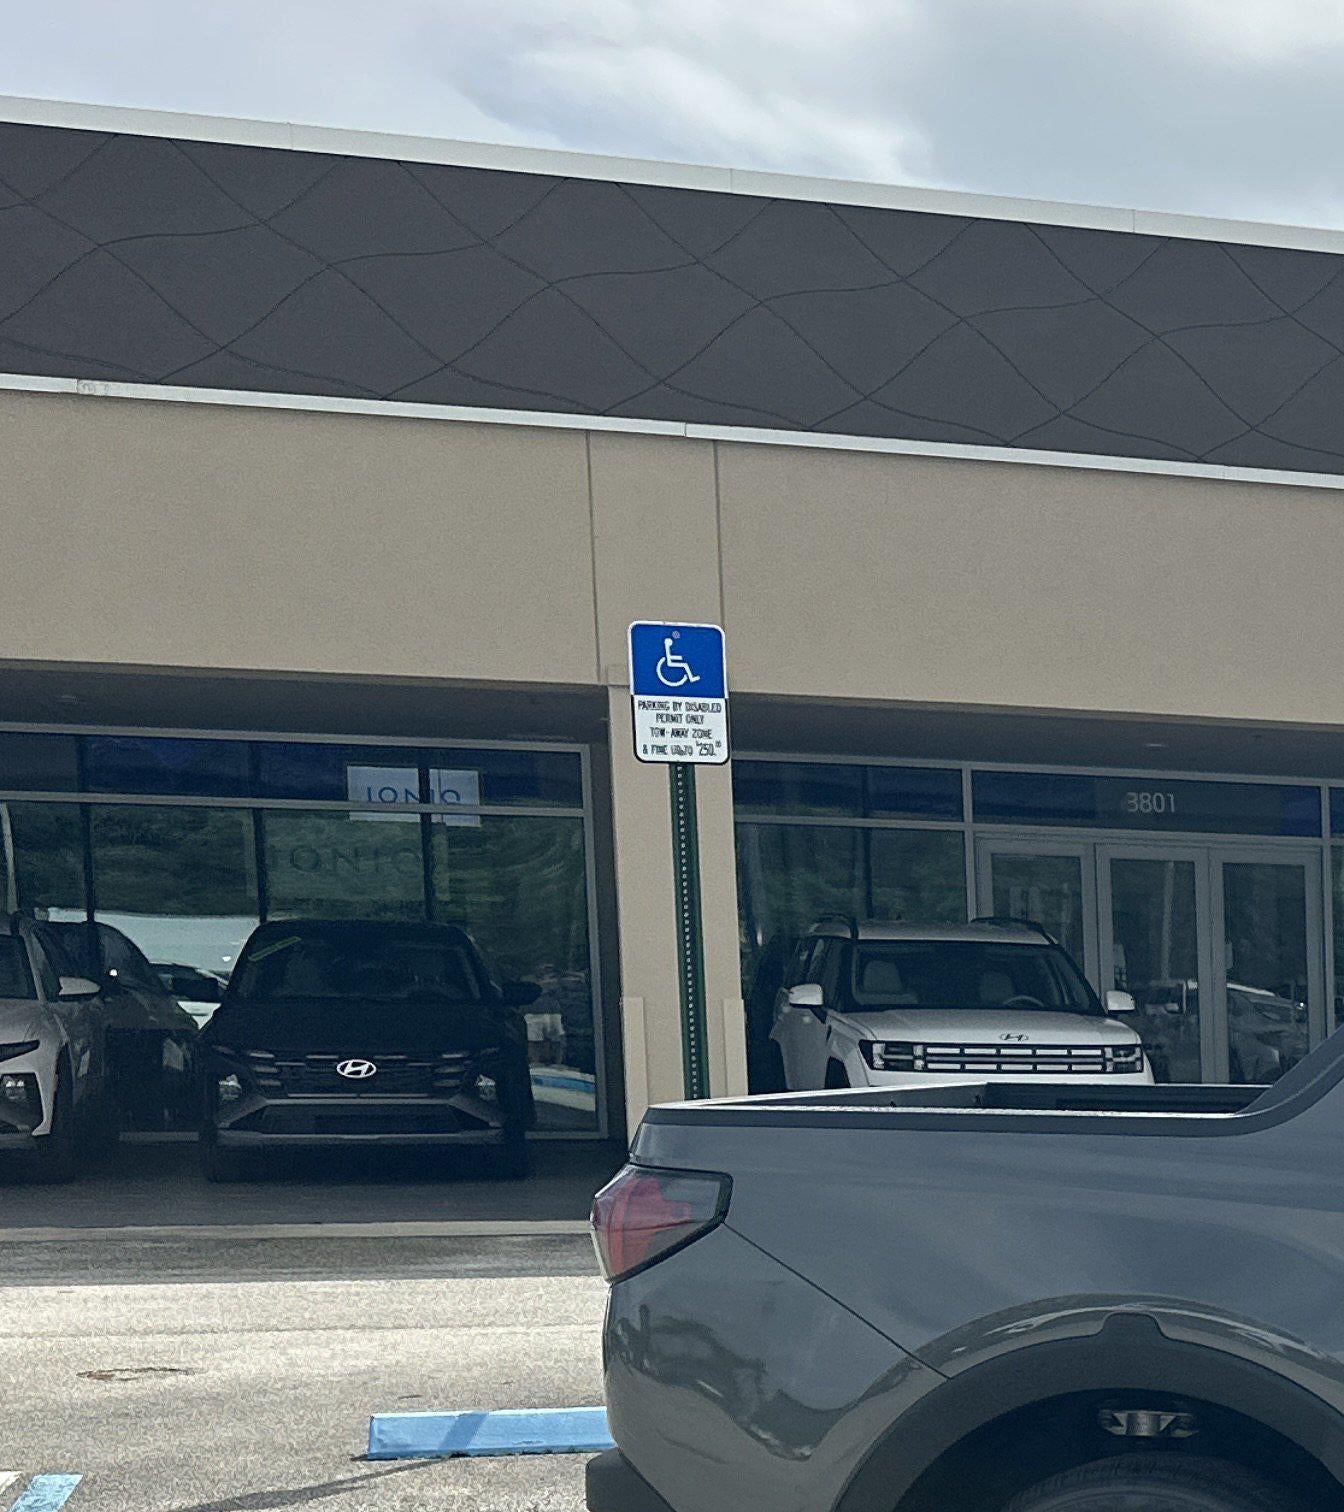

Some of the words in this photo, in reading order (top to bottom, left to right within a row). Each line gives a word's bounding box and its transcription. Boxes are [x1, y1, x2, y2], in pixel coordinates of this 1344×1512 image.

[638, 700, 670, 711] PARKING
[672, 702, 682, 712] BY
[685, 702, 721, 713] DISABLED
[656, 713, 683, 723] PERMIT
[686, 714, 704, 724] ONLY
[692, 729, 712, 739] ZONE
[651, 745, 668, 755] FINE
[1126, 791, 1175, 813] 3801
